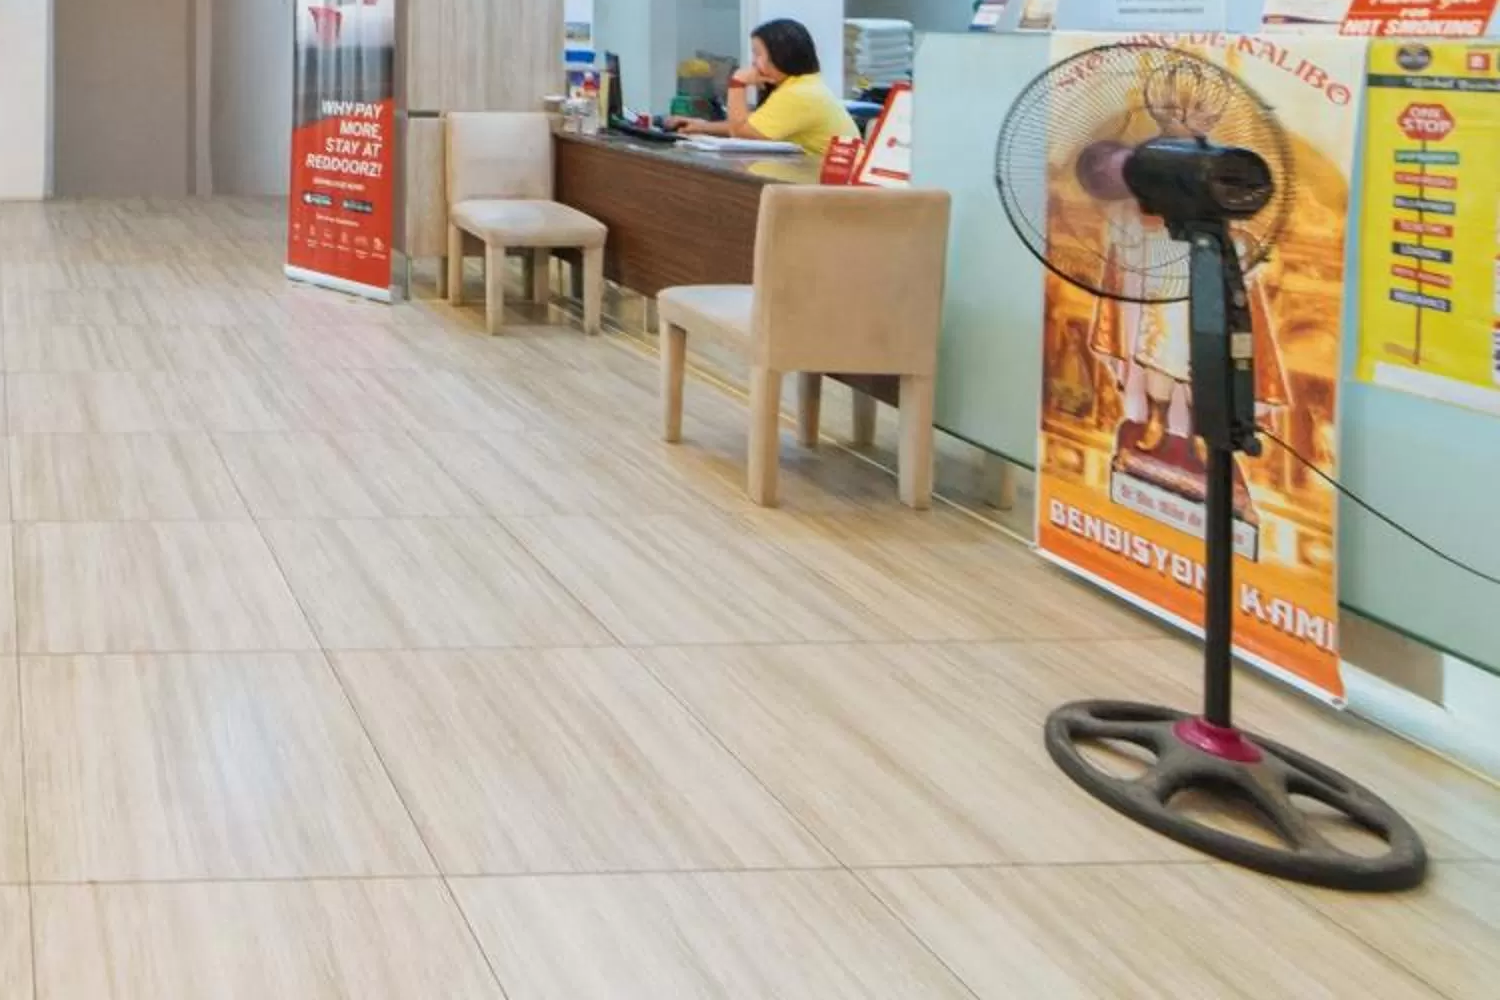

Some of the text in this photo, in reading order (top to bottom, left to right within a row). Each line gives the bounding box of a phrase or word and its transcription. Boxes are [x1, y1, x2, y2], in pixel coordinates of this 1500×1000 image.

[1342, 18, 1484, 37] NOT SMOKING
[1235, 34, 1352, 106] KALIBO
[321, 99, 383, 120] WHY PAY
[1400, 117, 1453, 134] STOP
[325, 136, 383, 158] STAY AT
[1240, 583, 1336, 652] KAMI
